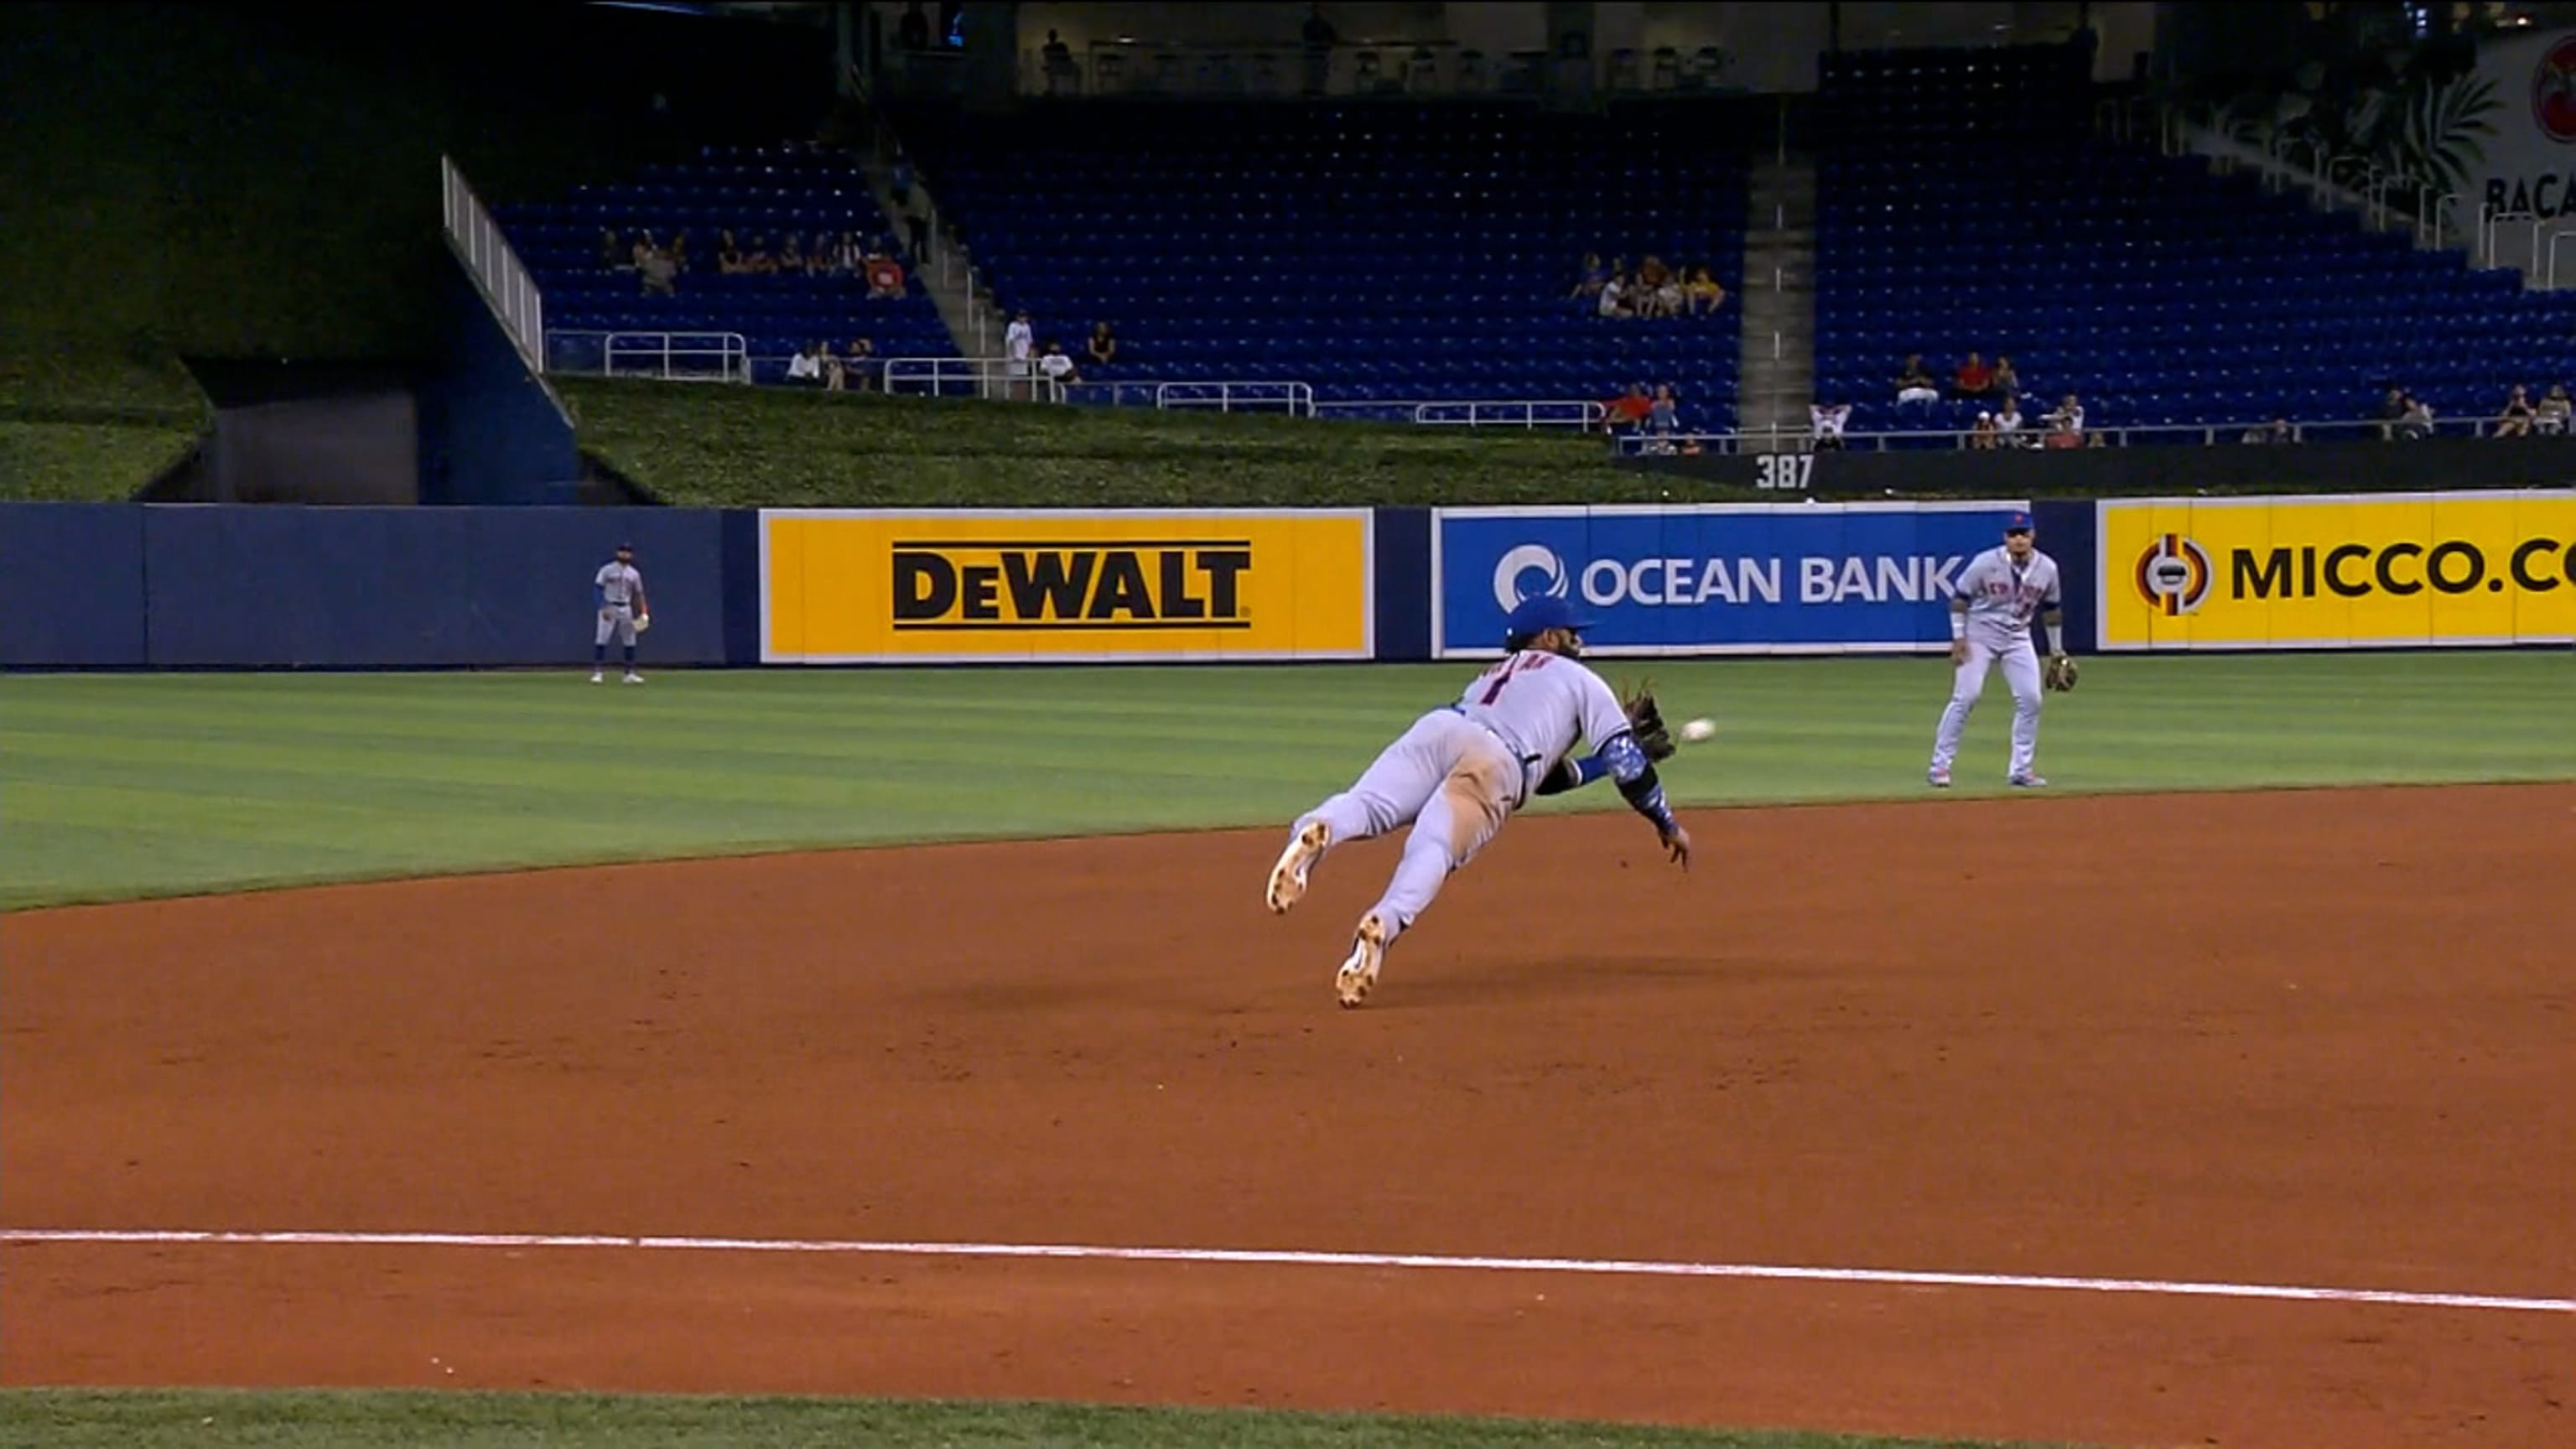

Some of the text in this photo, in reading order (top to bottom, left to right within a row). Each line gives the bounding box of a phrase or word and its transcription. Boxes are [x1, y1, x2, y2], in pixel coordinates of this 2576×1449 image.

[1757, 454, 1814, 488] 387
[1581, 558, 1780, 605] OCEAN
[1800, 557, 1963, 603] BANK
[2232, 538, 2576, 599] MICCO.C
